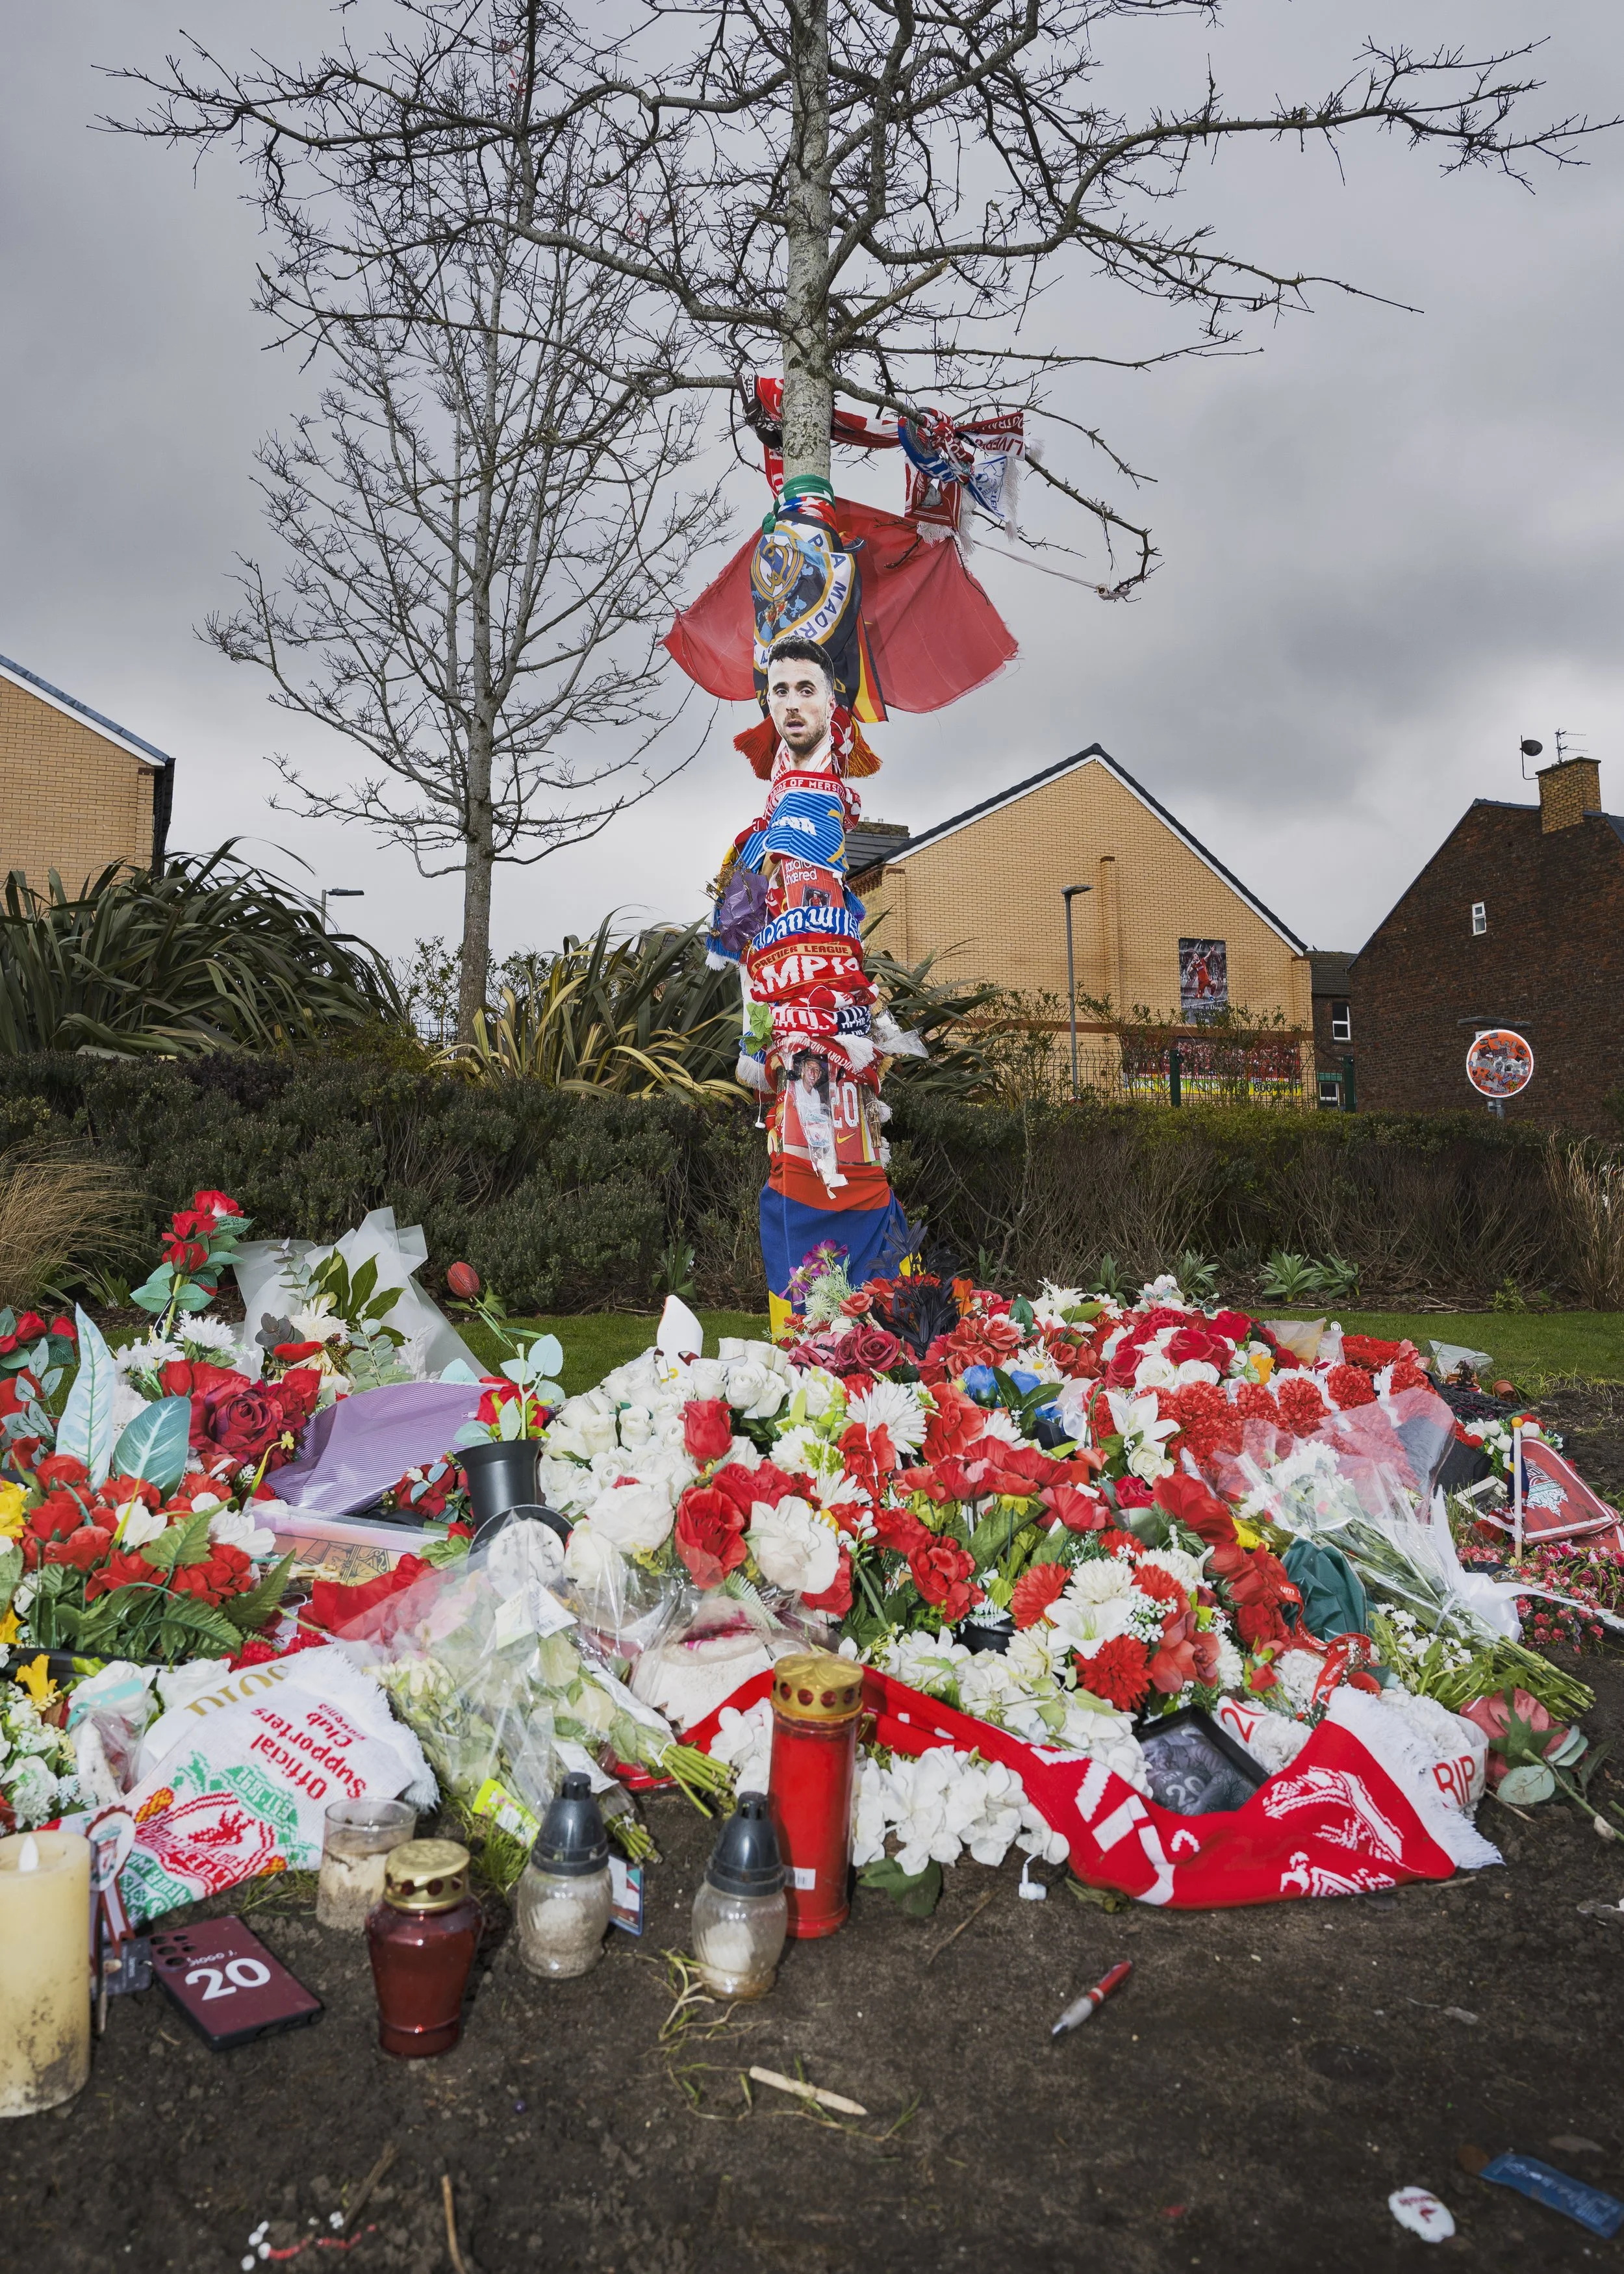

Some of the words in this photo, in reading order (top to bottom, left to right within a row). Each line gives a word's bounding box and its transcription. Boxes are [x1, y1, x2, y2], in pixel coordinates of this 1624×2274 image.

[754, 945, 798, 970] PREMIER
[804, 945, 849, 954] LEAGUE
[829, 1081, 859, 1129] 20
[305, 1712, 353, 1748] Club
[249, 1733, 327, 1800] Official
[250, 1707, 368, 1799] Supporters
[1160, 1770, 1184, 1783] JOTA
[1166, 1776, 1206, 1807] 20
[1432, 1756, 1476, 1809] RIP
[184, 1958, 271, 2001] 20
